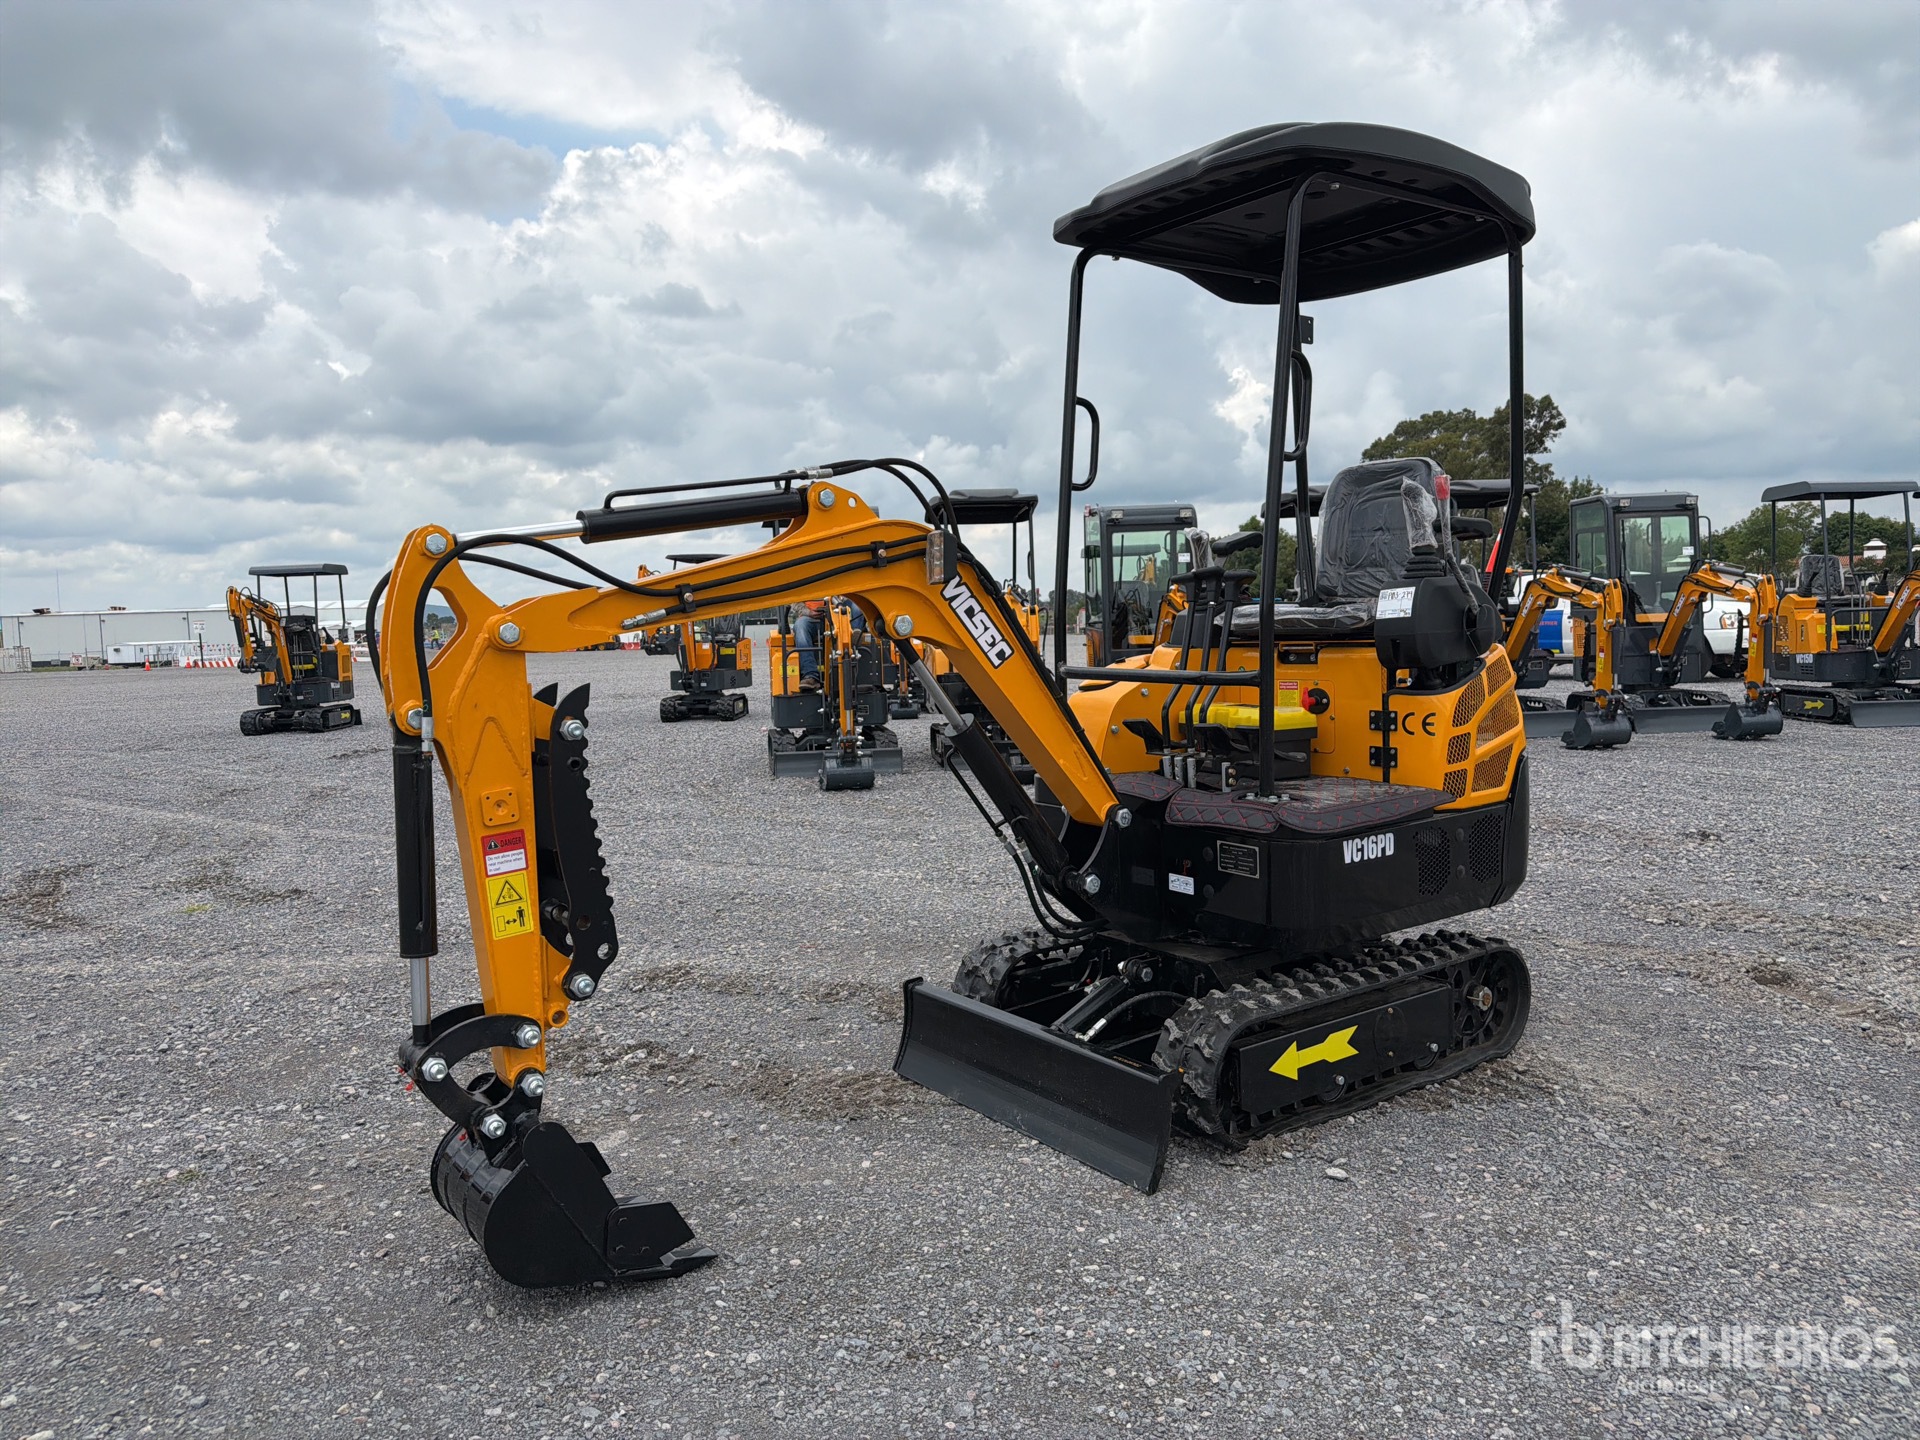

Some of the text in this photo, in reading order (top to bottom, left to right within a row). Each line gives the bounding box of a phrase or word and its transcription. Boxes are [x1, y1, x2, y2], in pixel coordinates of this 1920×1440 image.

[942, 575, 1013, 667] VICSEC
[500, 837, 521, 847] DANGER
[1342, 832, 1395, 864] VC16PD
